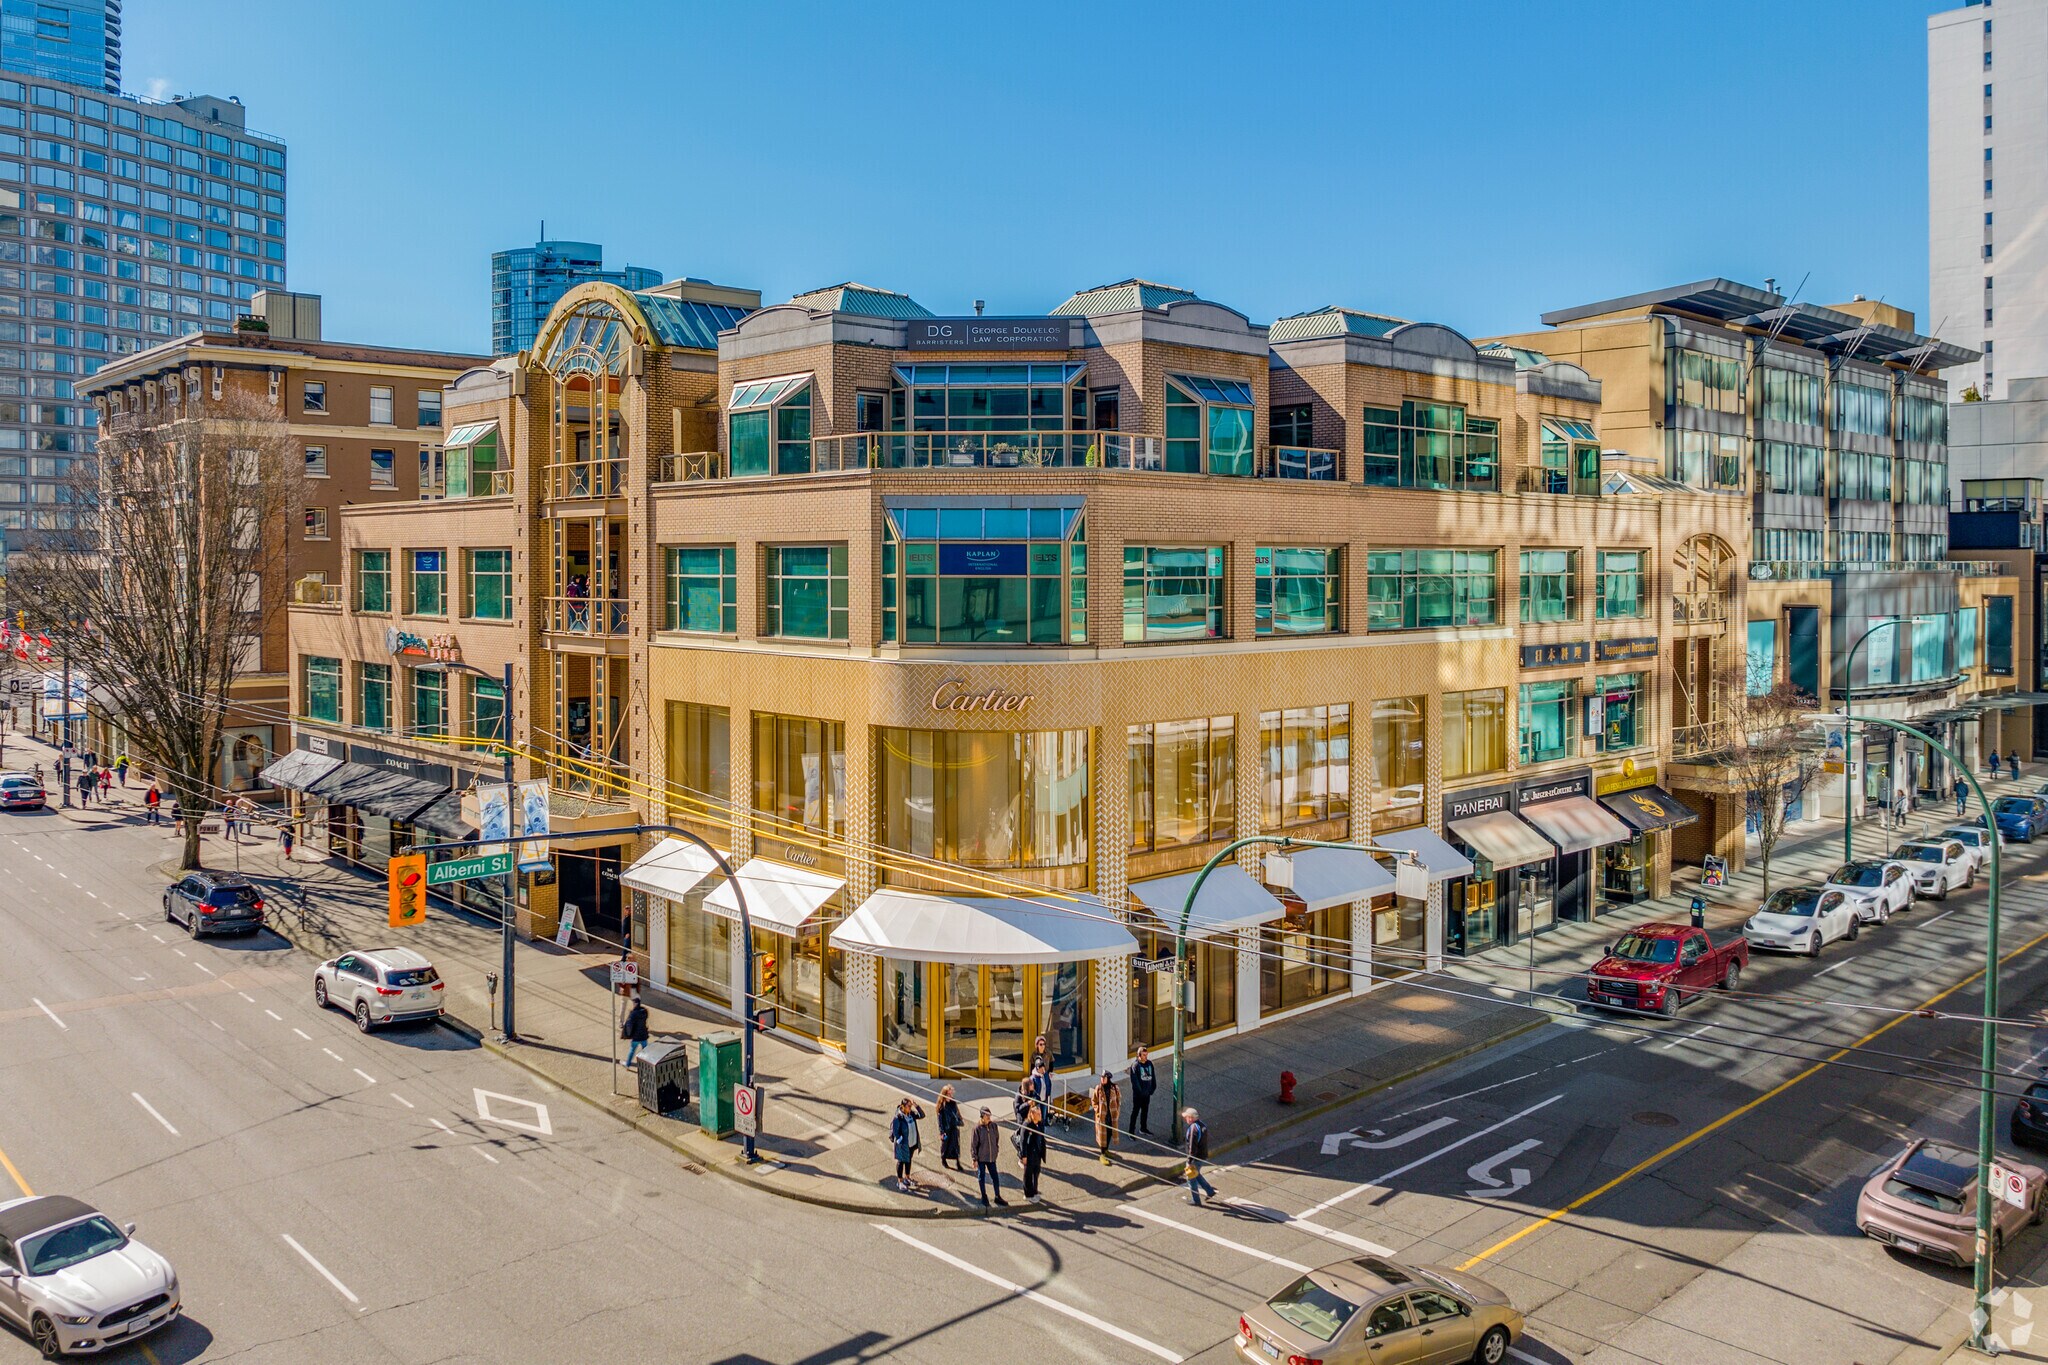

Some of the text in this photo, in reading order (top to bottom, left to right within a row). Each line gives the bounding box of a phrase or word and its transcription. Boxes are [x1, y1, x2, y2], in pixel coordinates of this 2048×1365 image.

[927, 325, 953, 337] DG
[971, 326, 1008, 334] GEORGE
[909, 554, 933, 562] IELTS
[1033, 554, 1057, 562] IELTS
[932, 681, 1035, 712] Cartier
[385, 758, 410, 770] COACH
[1454, 797, 1503, 816] PANERAI
[785, 845, 817, 866] Cartier
[434, 858, 508, 881] Alberni St
